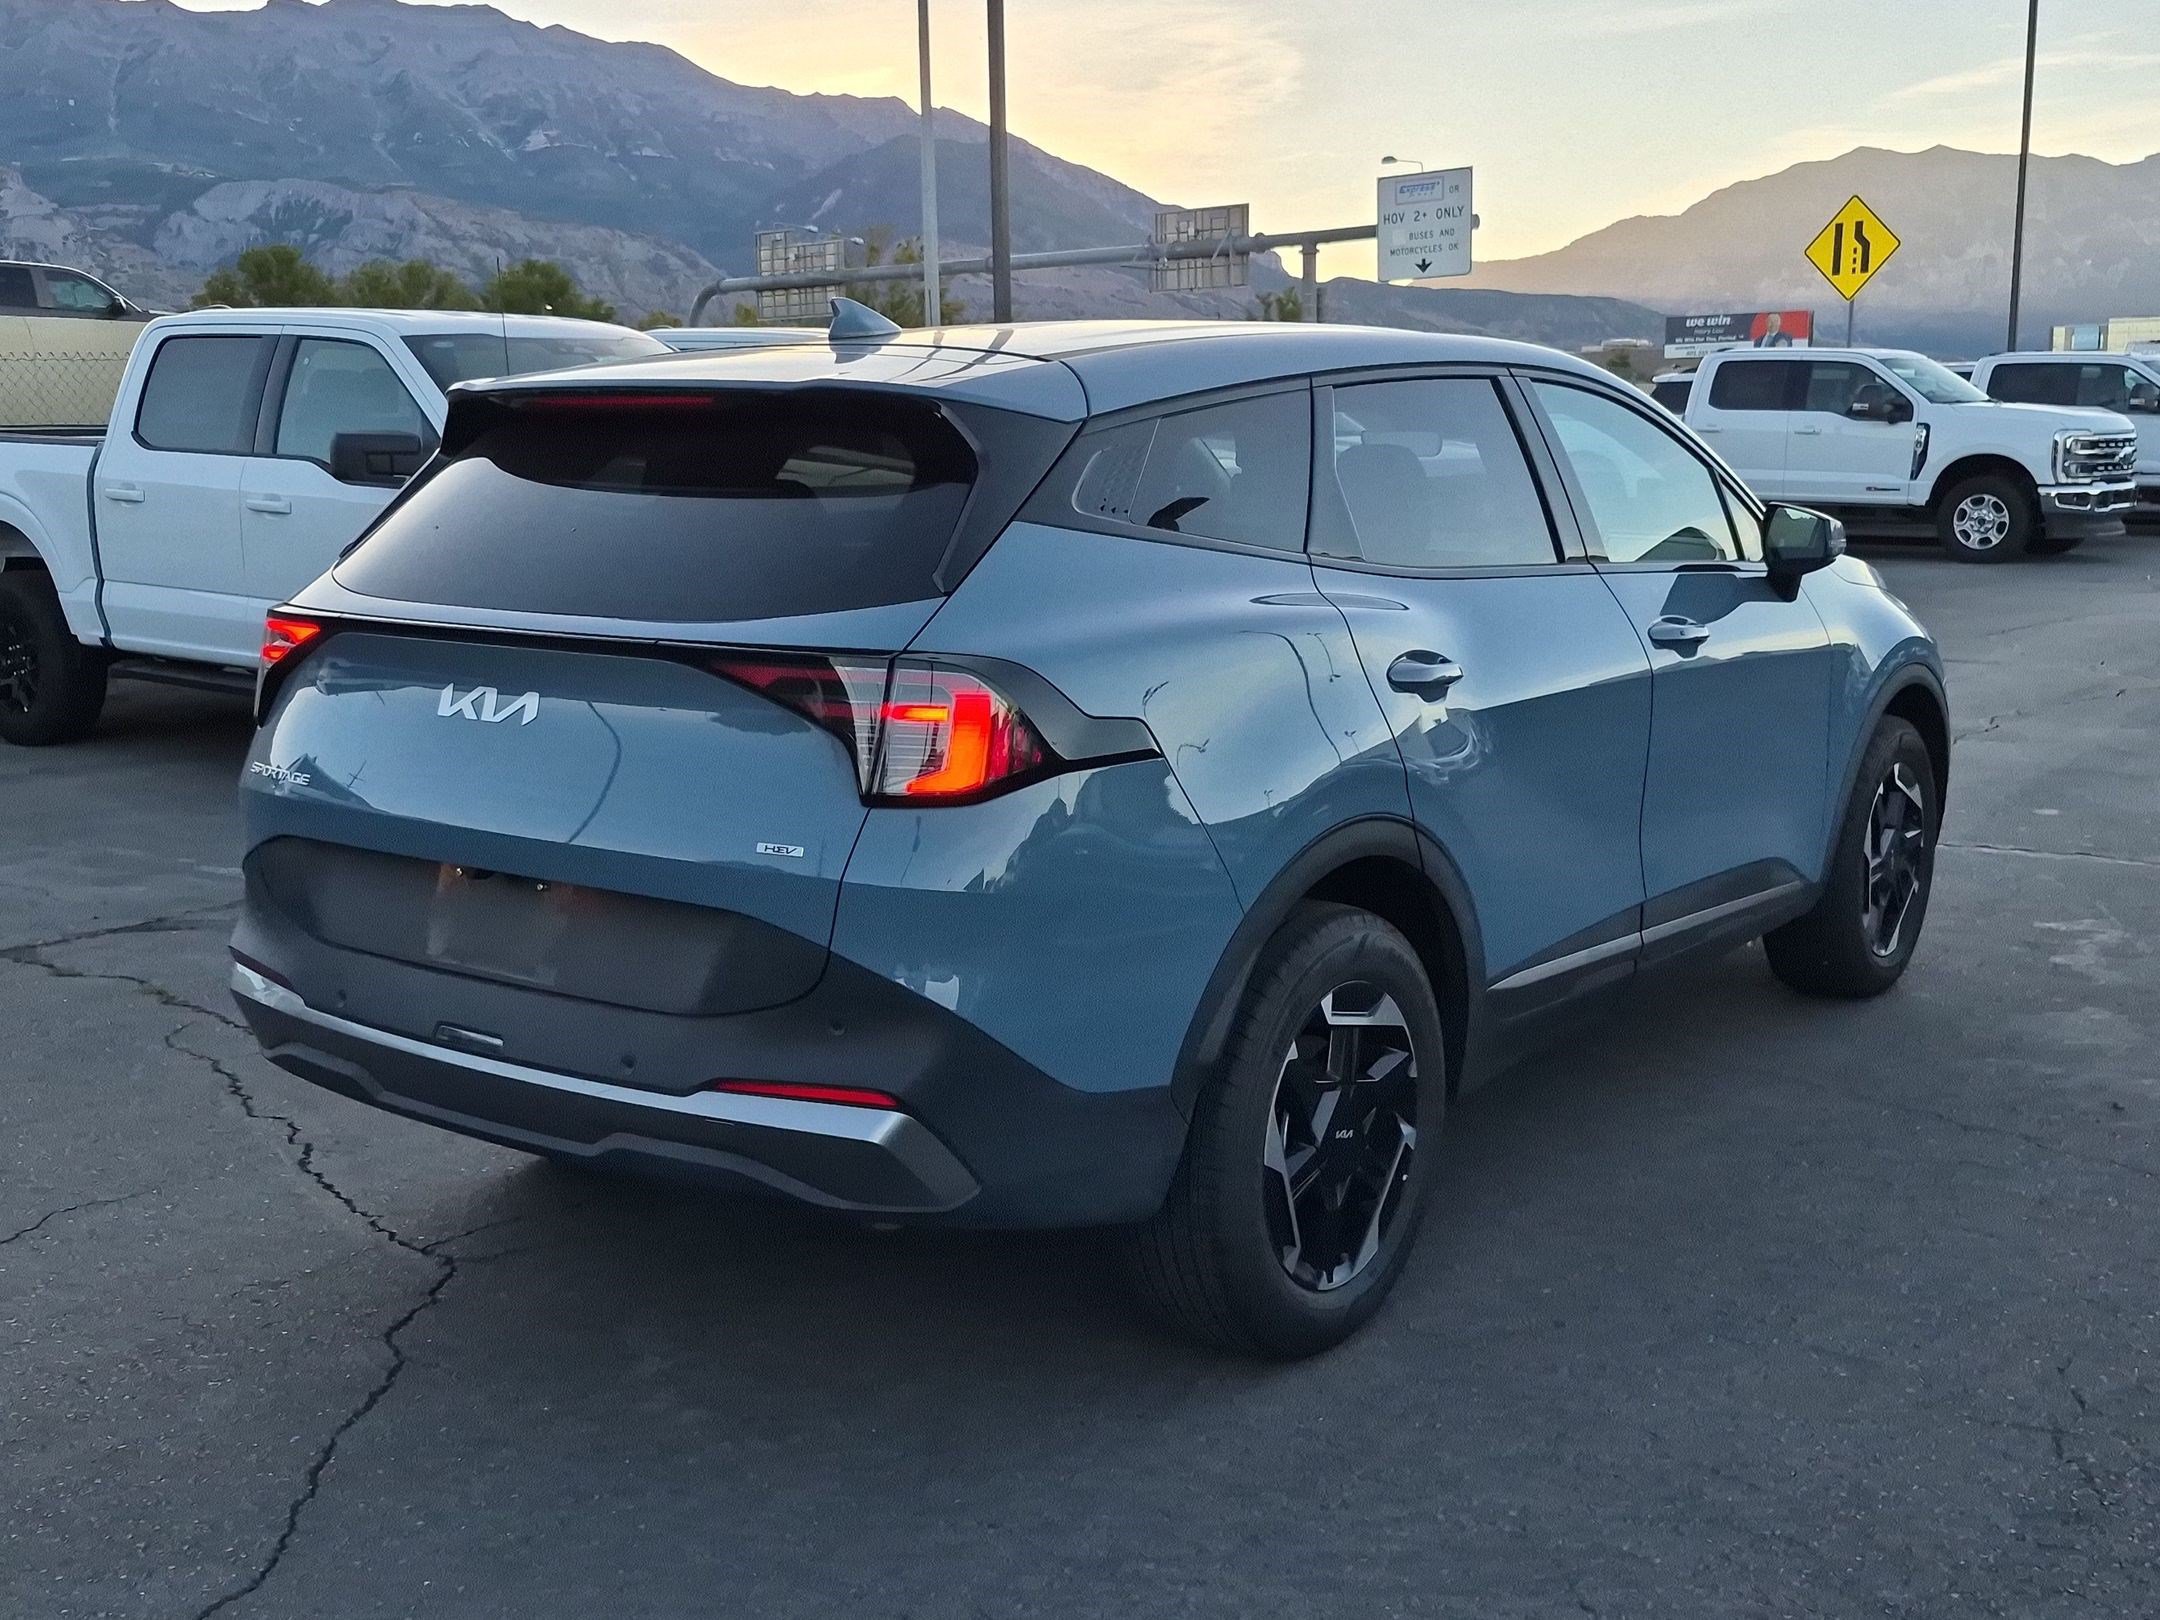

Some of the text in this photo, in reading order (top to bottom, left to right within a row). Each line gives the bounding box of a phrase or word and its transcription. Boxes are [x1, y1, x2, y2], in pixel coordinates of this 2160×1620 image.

[1449, 185, 1460, 193] OR
[1384, 205, 1464, 225] HOV 2+ ONLY
[1409, 228, 1455, 241] BUSES AND
[1390, 242, 1459, 256] MOTORCYCLES OK
[1685, 315, 1731, 327] we win
[437, 682, 540, 727] KIA
[250, 761, 311, 786] SPORTAGE
[764, 845, 797, 854] HEV
[1335, 1129, 1353, 1139] KIA
